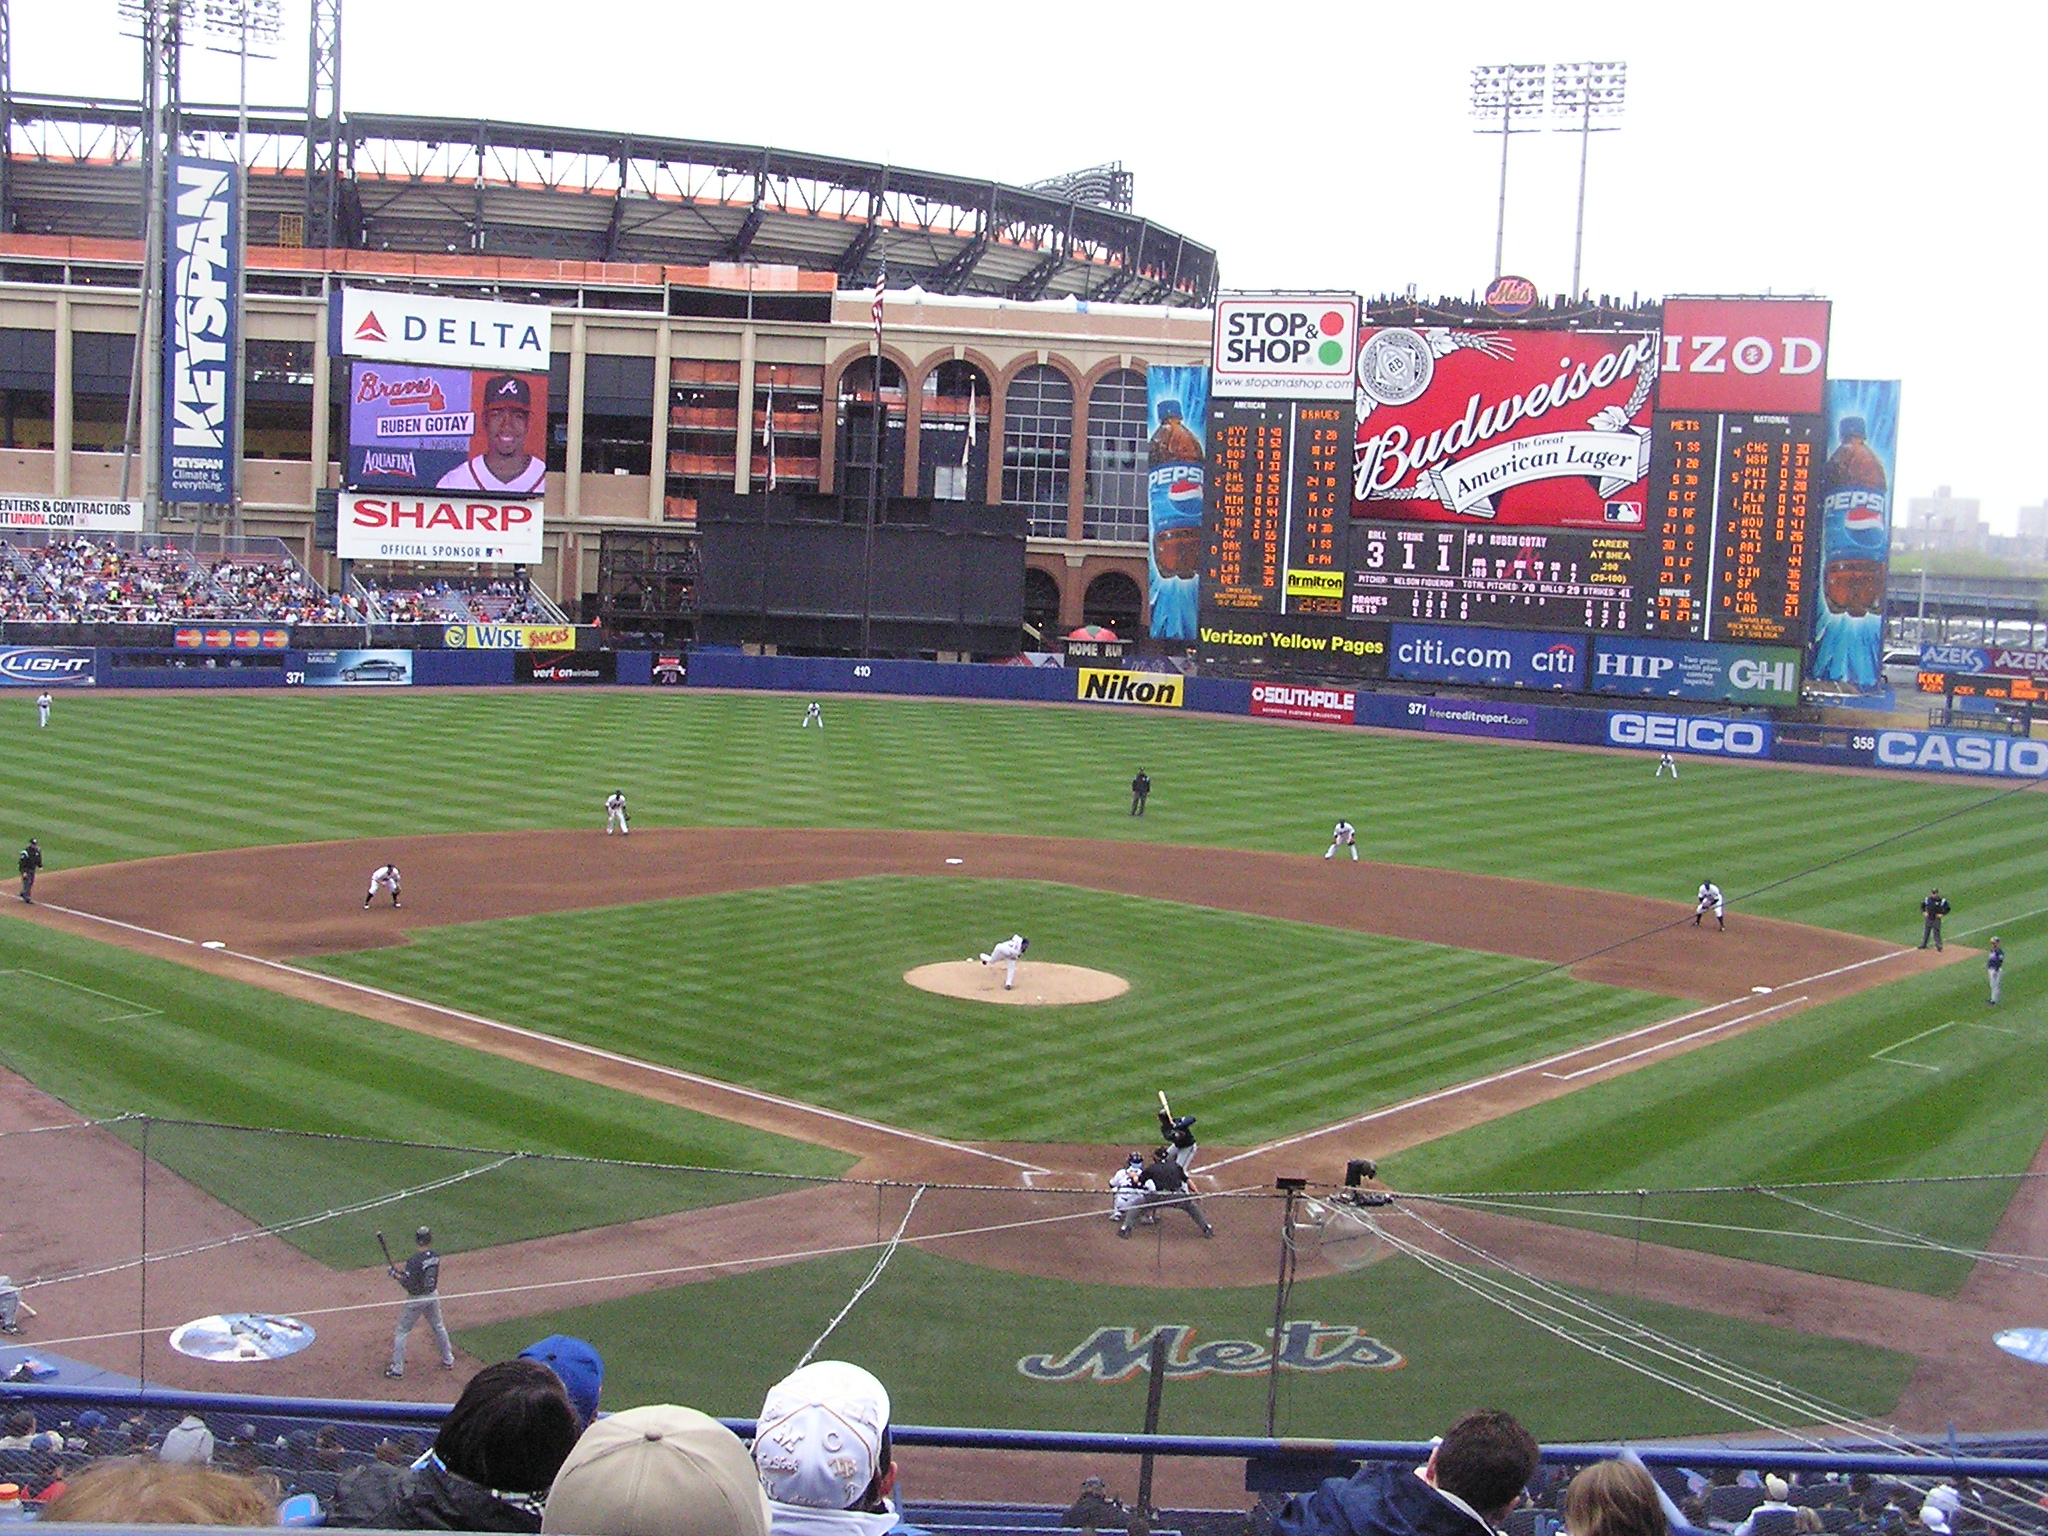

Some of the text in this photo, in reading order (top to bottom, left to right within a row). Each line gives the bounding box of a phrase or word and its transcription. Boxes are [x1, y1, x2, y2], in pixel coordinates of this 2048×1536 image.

[173, 166, 229, 448] KEYSPAN
[404, 316, 542, 351] DELTA
[1228, 313, 1319, 340] STOP &
[1227, 339, 1310, 363] SHOP
[1661, 336, 1822, 375] IZOD
[357, 371, 431, 403] Braves
[1215, 377, 1354, 389] www.stopandshop.com
[381, 416, 469, 433] RUBEN GOTAY
[1355, 334, 1650, 500] Budweiser
[1671, 420, 1699, 431] METS
[1227, 438, 1246, 447] CLE
[1511, 435, 1564, 452] The Great
[1747, 442, 1768, 453] CHC
[173, 457, 223, 470] KEYSPAN
[363, 449, 416, 477] AQUAFINA
[172, 469, 220, 480] Climate is
[1457, 445, 1633, 498] American Lager
[1745, 468, 1767, 478] PHI
[1744, 480, 1767, 490] PIT
[1743, 492, 1765, 502] FLA
[42, 500, 51, 513] &
[53, 500, 131, 516] CONTRACTORS
[353, 499, 532, 531] SHARP
[1742, 504, 1763, 514] MIL
[1368, 530, 1453, 543] BALL STRIKE OUT
[1490, 535, 1547, 548] RUBEN GOTAY
[1741, 529, 1761, 540] STL
[381, 545, 481, 558] OFFICIAL SPONSOR
[1592, 539, 1629, 549] CAREER
[1367, 541, 1384, 568] 3
[1402, 543, 1415, 569] 1
[1437, 545, 1450, 571] 1
[1590, 551, 1631, 561] AT SHEA
[1288, 574, 1342, 588] Armitron
[1394, 577, 1420, 586] NELSON
[1463, 580, 1485, 589] TOTAL
[1522, 584, 1535, 592] 70
[1737, 579, 1751, 589] SF
[1737, 592, 1758, 602] COL
[1352, 595, 1626, 619] BRAVES 0 0 0 0 0 3 0
[1735, 604, 1758, 614] LAD
[1351, 605, 1625, 629] METS 1 2 1 0 4 7 0
[476, 627, 570, 648] WISE SNACKS
[1200, 628, 1384, 656] Verizon Yellow Pages
[1068, 643, 1123, 658] HOME RUN
[1398, 639, 1575, 673] citi.com citi
[1922, 646, 1975, 665] AZEK
[5, 657, 90, 671] LIGHT
[854, 665, 871, 678] 410
[286, 672, 305, 684] 371
[1597, 653, 1794, 692] HIP GHI
[1918, 672, 1945, 685] KKK
[1085, 674, 1176, 703] Nikon
[1265, 686, 1355, 710] SOUTHPOLE
[1408, 703, 1426, 716] 371
[1429, 708, 1529, 725] freecreditreport.com
[1610, 714, 1763, 754] GEICO
[1852, 736, 1875, 751] 358
[1878, 732, 2048, 775] CASIO
[1017, 1321, 1407, 1383] Mets
